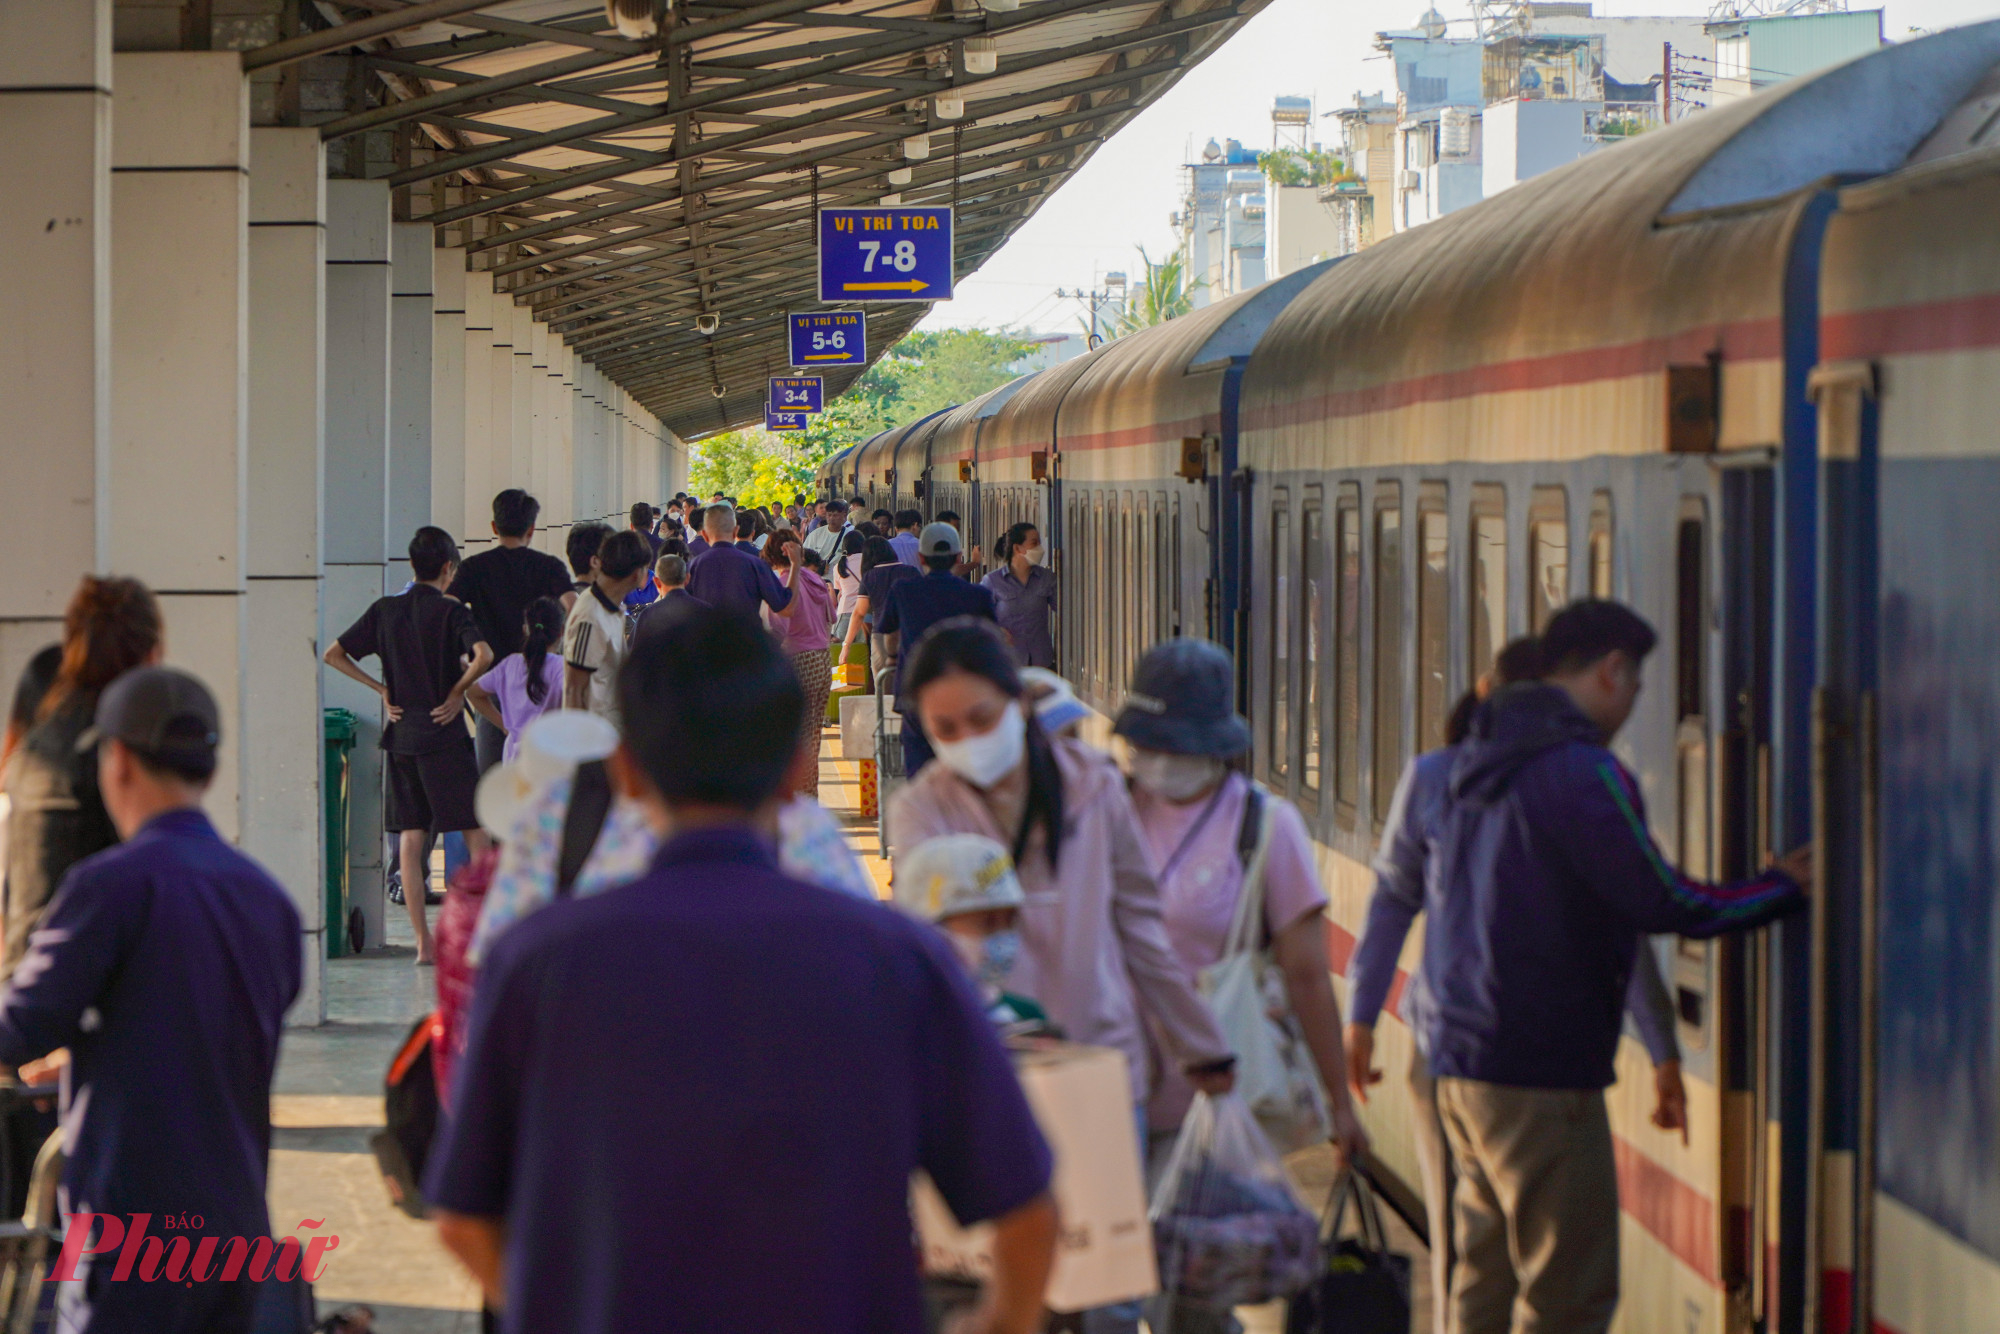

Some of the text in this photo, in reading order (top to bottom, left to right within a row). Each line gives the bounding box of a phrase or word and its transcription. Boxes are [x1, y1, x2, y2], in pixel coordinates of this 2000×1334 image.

[834, 213, 939, 234] VỊ TRÍ TOA
[858, 240, 917, 273] 7-8
[835, 315, 857, 325] TOA
[812, 330, 846, 350] 5-6
[785, 389, 809, 403] 3-4
